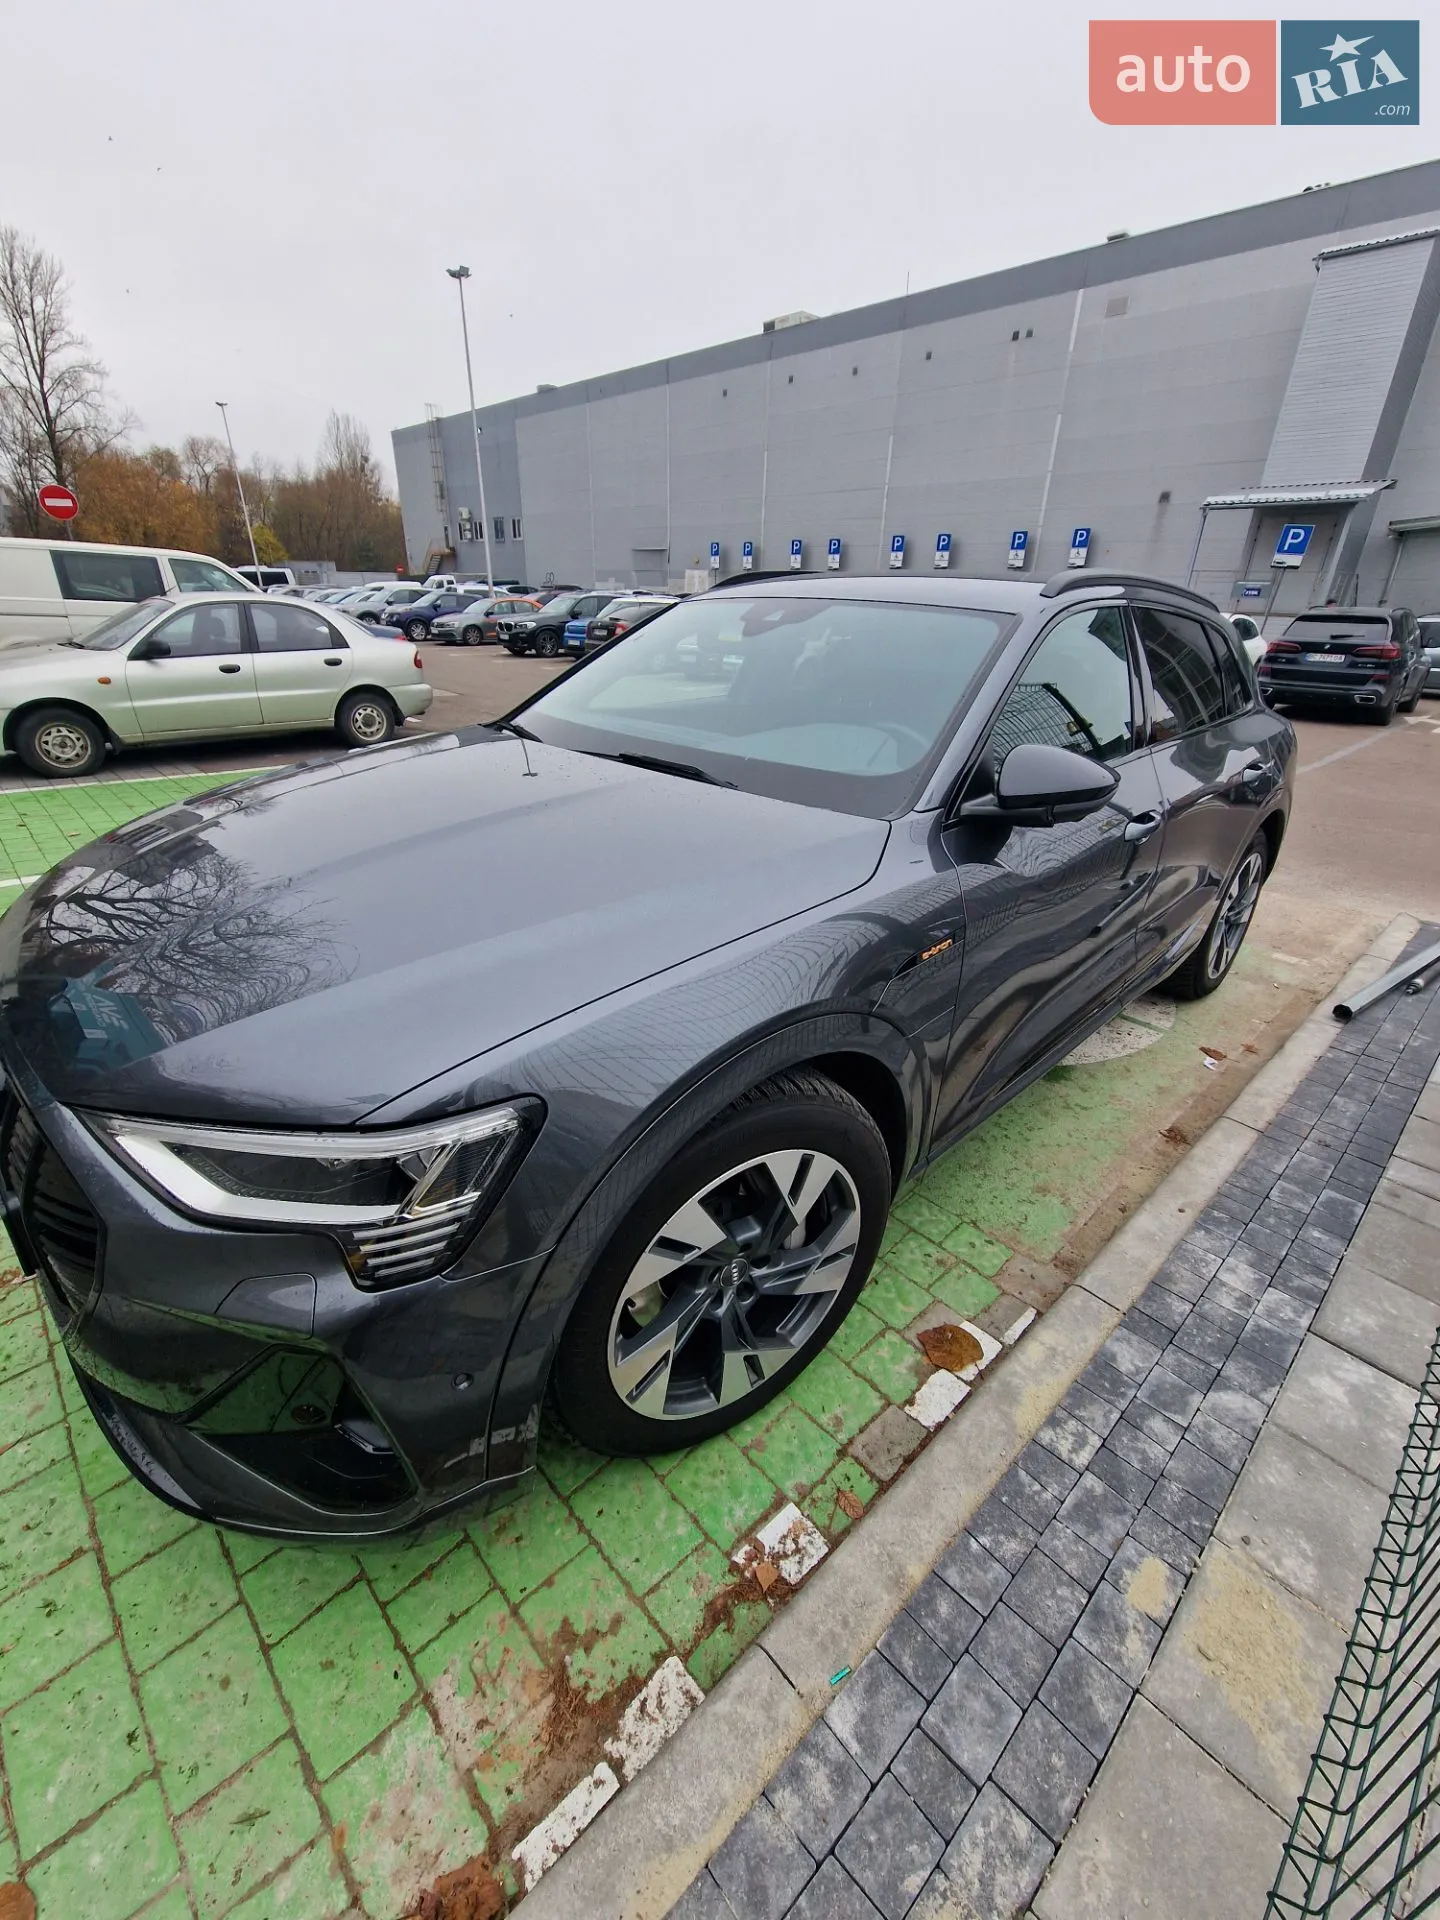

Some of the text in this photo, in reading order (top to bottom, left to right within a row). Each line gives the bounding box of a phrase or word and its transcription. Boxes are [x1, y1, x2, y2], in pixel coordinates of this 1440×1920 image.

[894, 537, 902, 550] P
[939, 536, 949, 550] P
[1013, 533, 1025, 548] P
[1075, 531, 1087, 546] P
[1283, 528, 1305, 551] P
[712, 543, 718, 555] P
[744, 543, 751, 554] P
[793, 541, 800, 553] P
[830, 540, 839, 553] P
